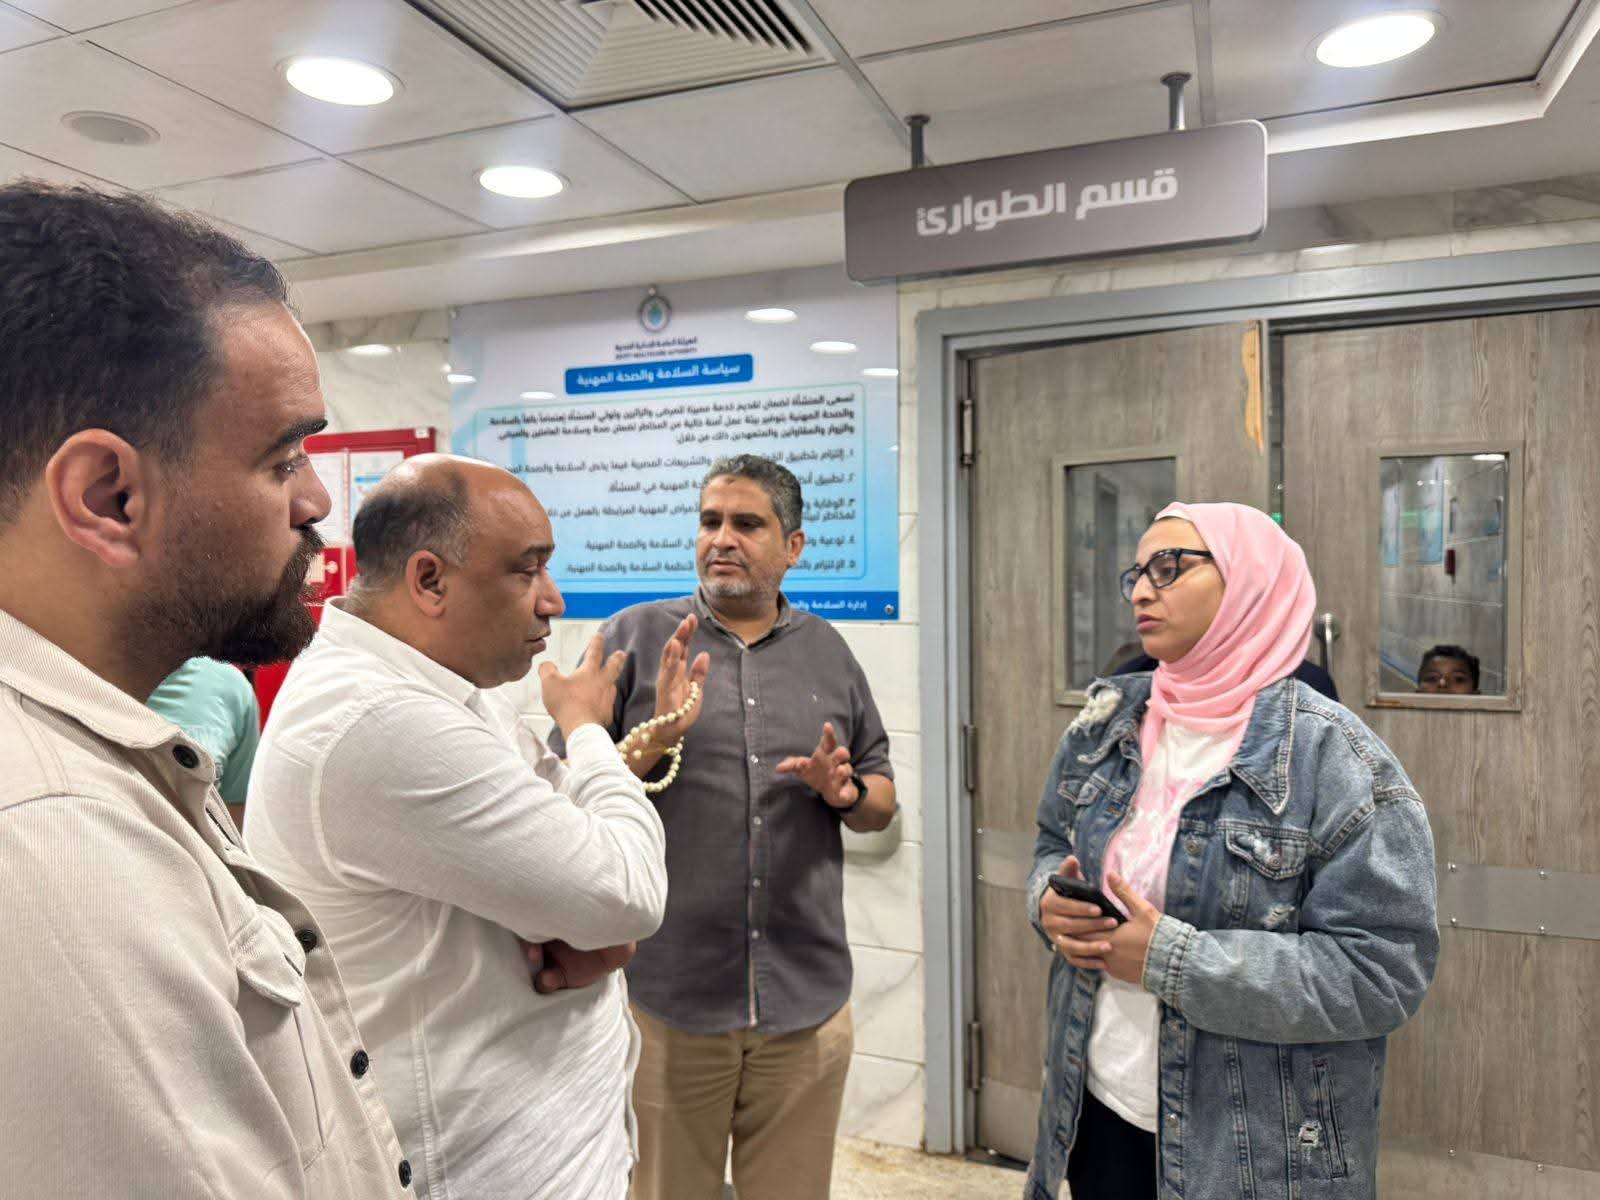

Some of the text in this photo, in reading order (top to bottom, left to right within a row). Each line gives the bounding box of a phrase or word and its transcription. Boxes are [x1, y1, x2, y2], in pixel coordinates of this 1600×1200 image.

[916, 167, 1178, 237] قسم الطوارئ
[576, 363, 742, 389] سياسة السلامة والصحة المهنية
[791, 395, 825, 407] المنشأة
[826, 392, 855, 407] تسعى
[788, 410, 820, 423] المهنية
[822, 408, 855, 420] والصحة
[724, 417, 742, 427] عمل
